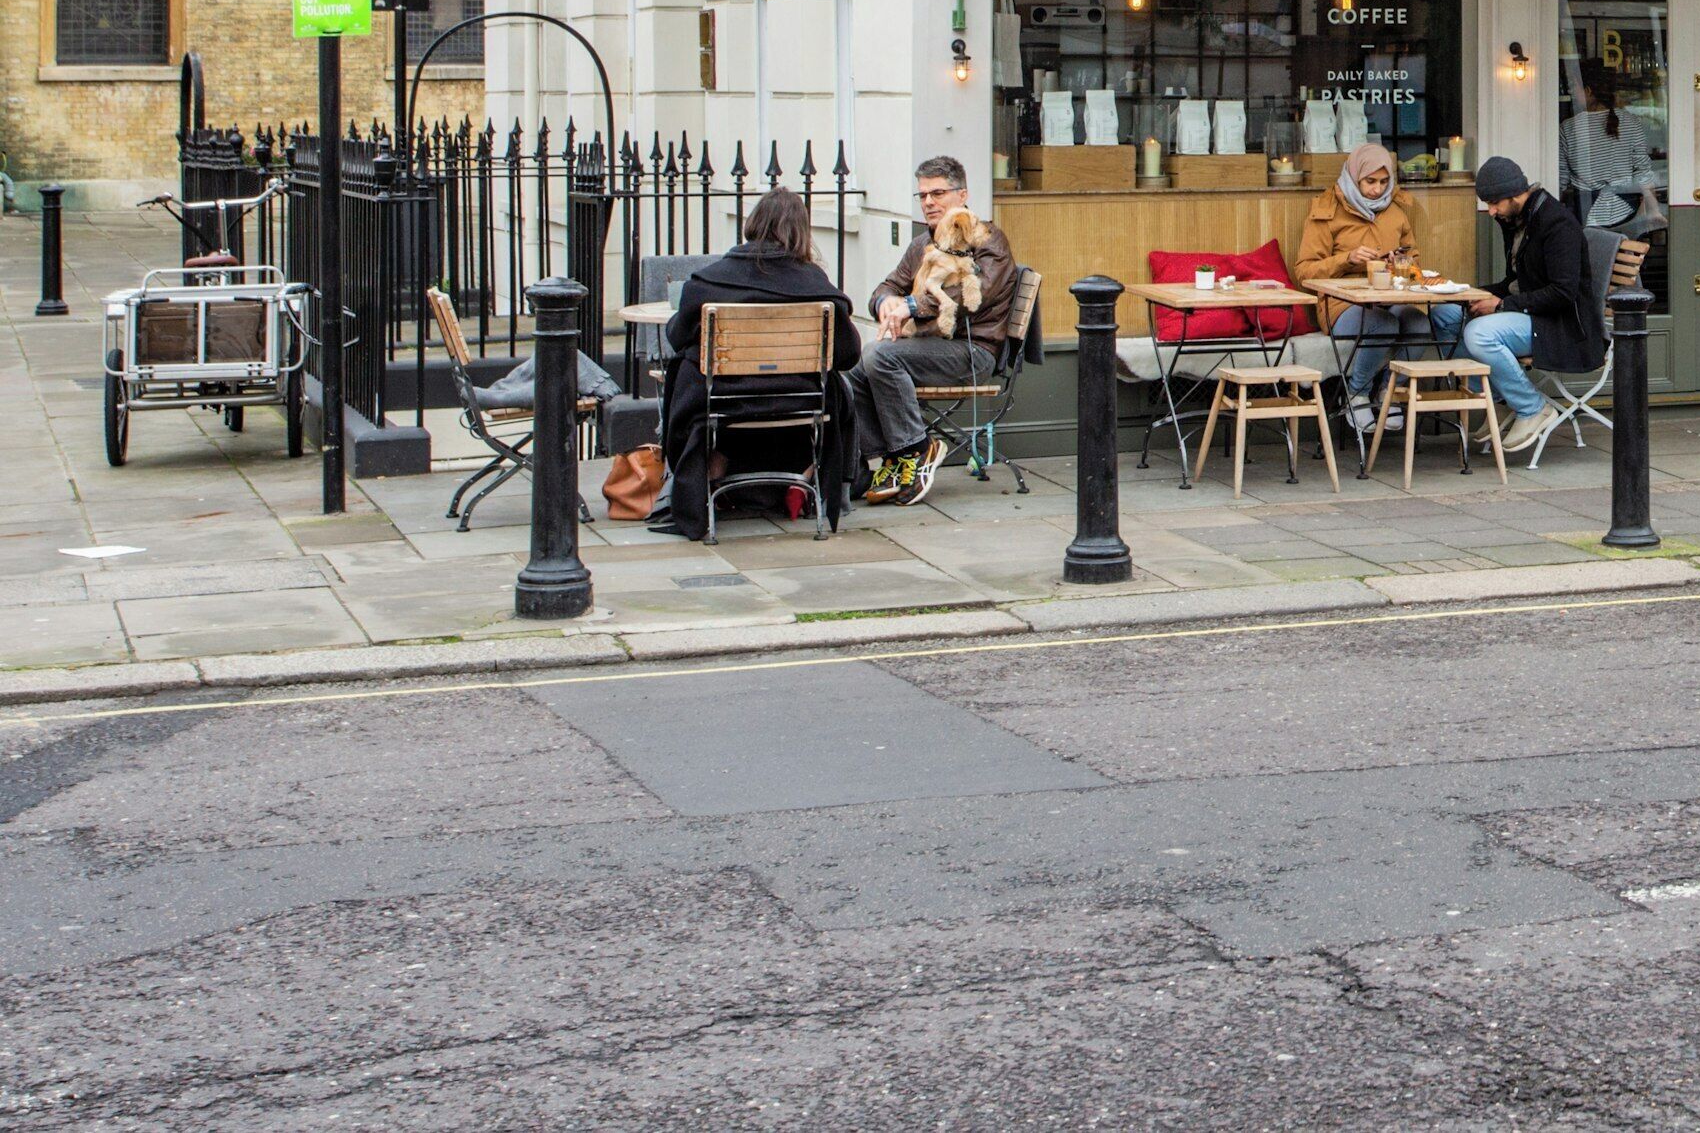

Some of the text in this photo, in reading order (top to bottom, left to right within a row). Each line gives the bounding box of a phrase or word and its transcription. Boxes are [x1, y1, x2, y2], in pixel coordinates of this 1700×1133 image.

[301, 4, 353, 17] POLLUTION.
[1327, 8, 1408, 24] COFFEE
[1603, 29, 1624, 68] B
[1327, 70, 1409, 81] DAILY BAKED
[1321, 88, 1415, 105] PASTRIES
